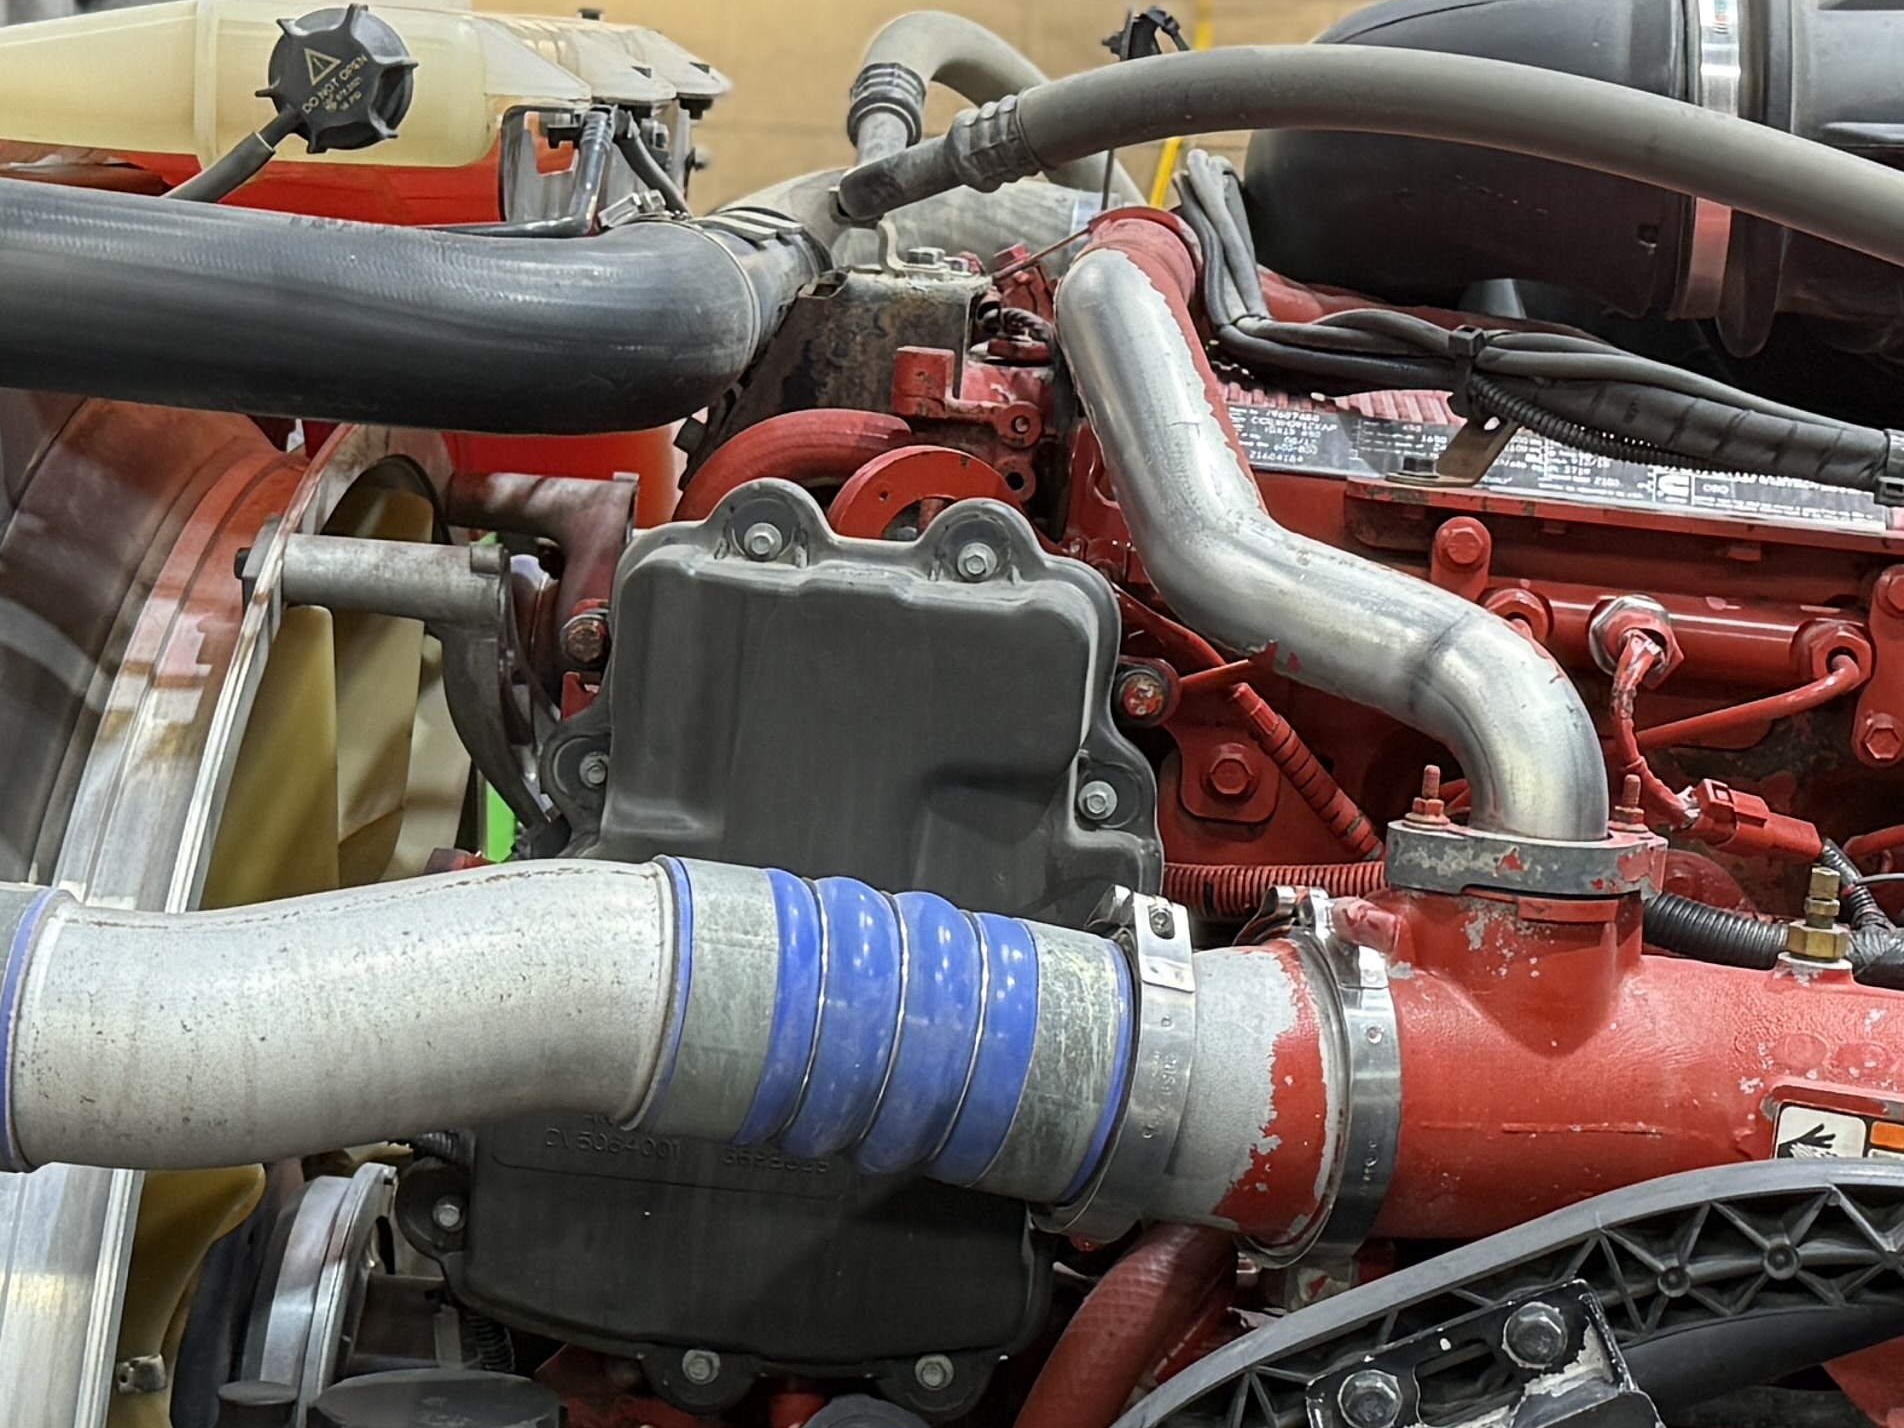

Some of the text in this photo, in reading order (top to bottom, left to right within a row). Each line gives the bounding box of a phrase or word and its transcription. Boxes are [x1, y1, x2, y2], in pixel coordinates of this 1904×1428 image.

[302, 96, 319, 114] DO
[318, 77, 339, 101] NOT
[339, 53, 368, 80] OPEN
